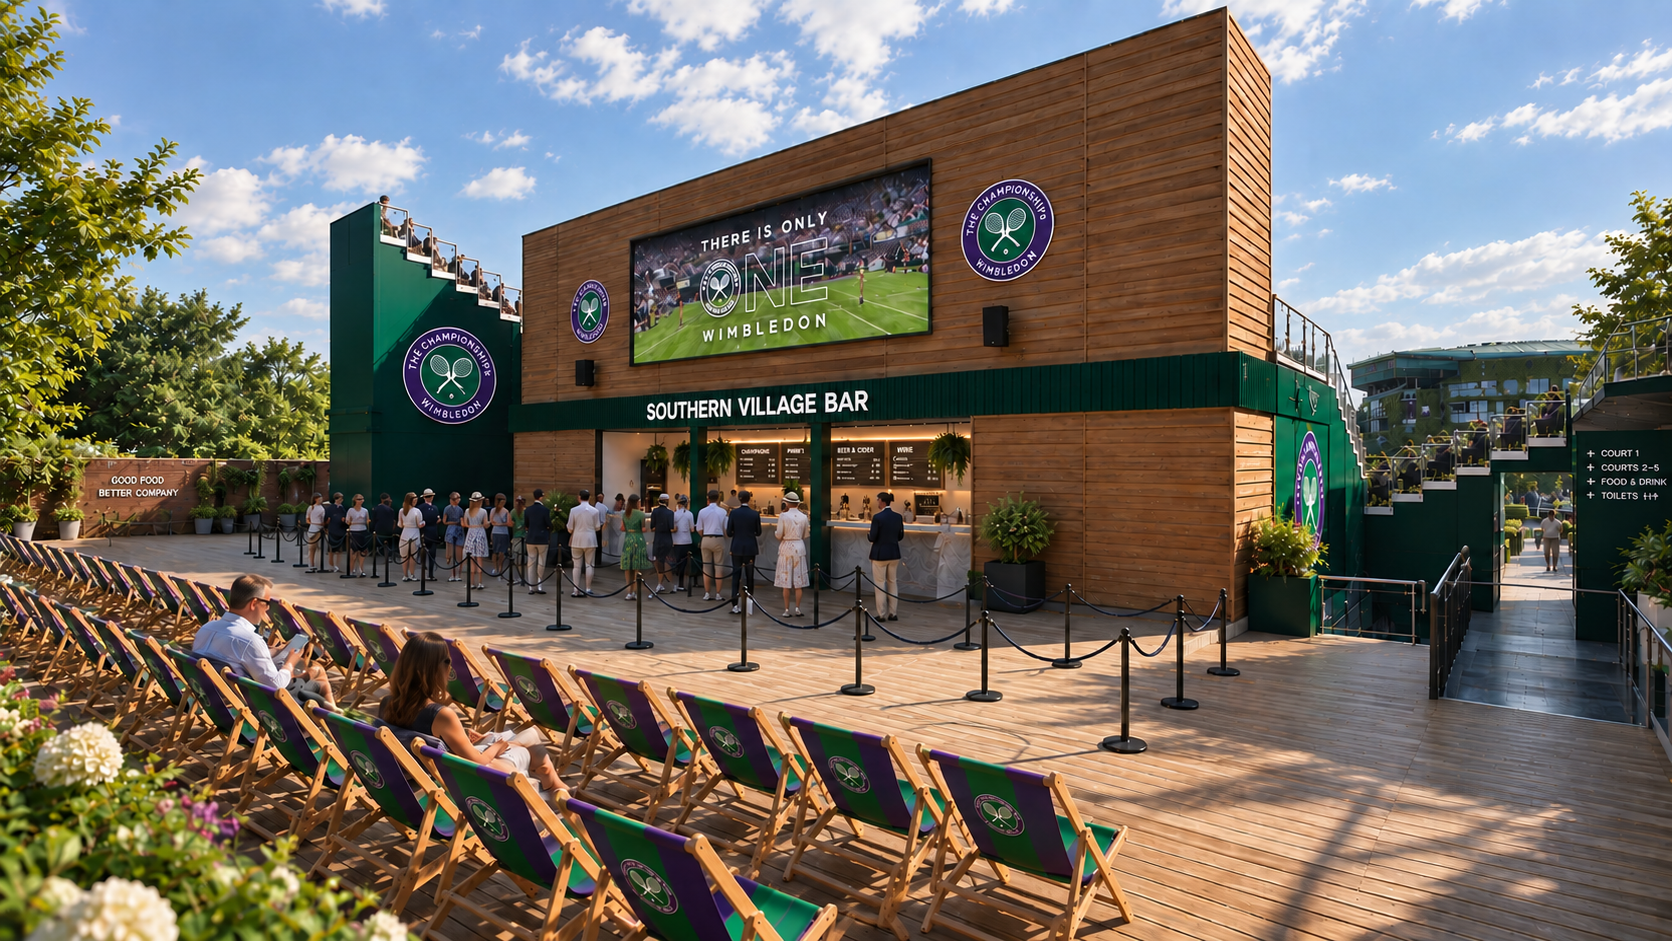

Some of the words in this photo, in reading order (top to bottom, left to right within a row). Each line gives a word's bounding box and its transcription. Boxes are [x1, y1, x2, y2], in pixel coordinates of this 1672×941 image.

[701, 230, 750, 252] THERE
[757, 224, 772, 239] IS
[781, 211, 828, 234] ONLY
[966, 213, 979, 236] THE
[976, 250, 1037, 276] WIMBLEDON
[702, 313, 826, 343] WIMBLEDON
[408, 349, 422, 370] THE
[421, 397, 481, 419] WIMBLEDON
[646, 398, 732, 421] SOUTHERN
[738, 393, 817, 416] VILLAGE
[824, 390, 869, 413] BAR
[1601, 449, 1633, 458] COURT
[1635, 449, 1640, 457] 1
[1601, 463, 1639, 472] COURTS
[111, 475, 137, 485] GOOD
[140, 476, 165, 485] FOOD
[1601, 477, 1628, 486] FOOD
[1630, 478, 1636, 486] &
[1639, 478, 1668, 486] DRINK
[98, 488, 132, 497] BETTER
[135, 488, 179, 497] COMPANY
[1601, 491, 1639, 500] TOILETS
